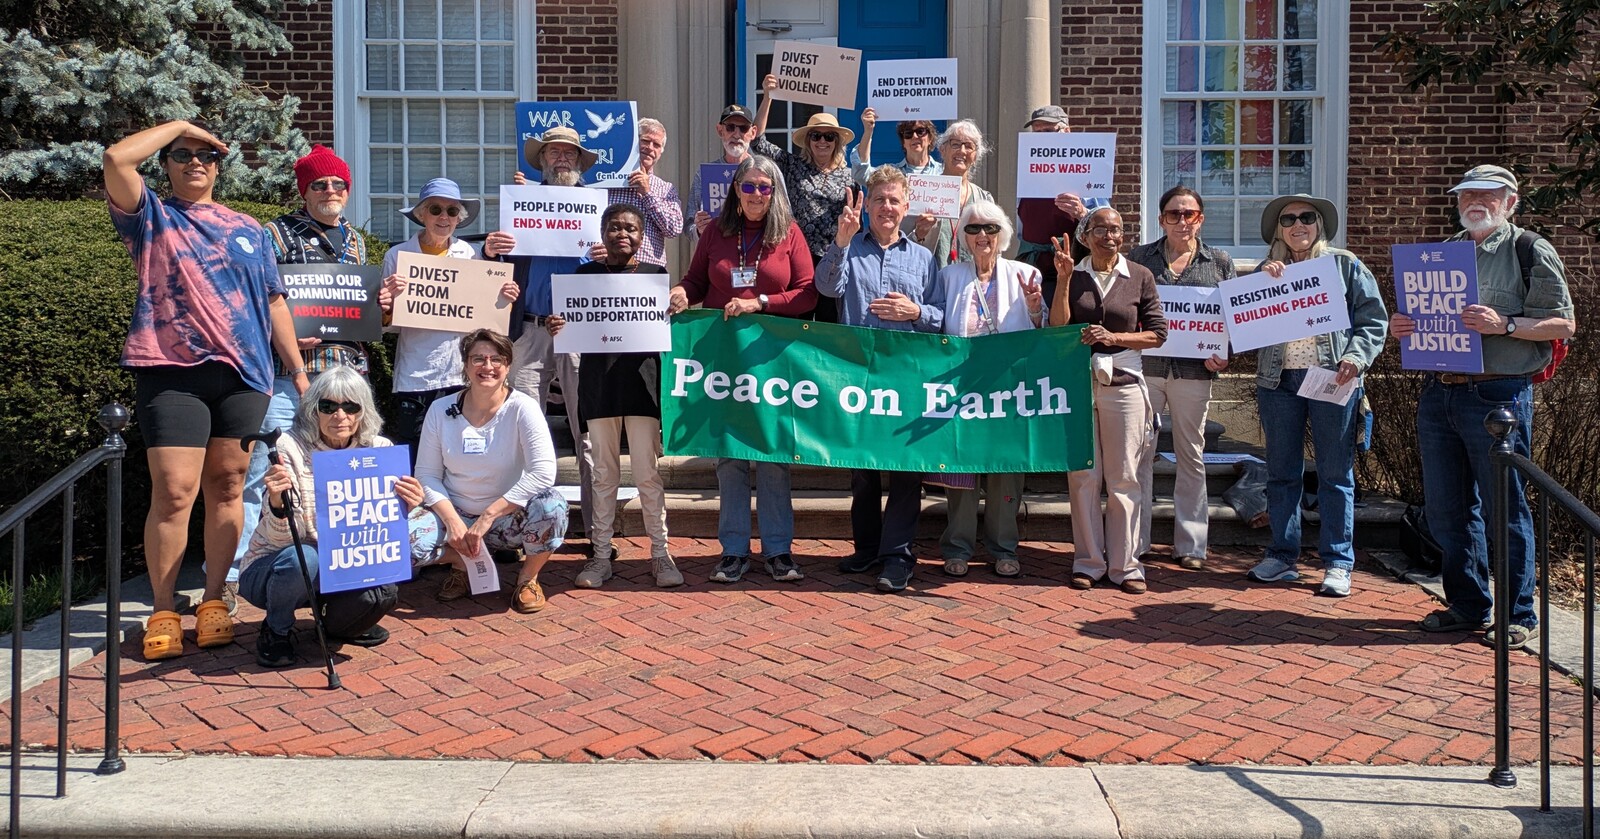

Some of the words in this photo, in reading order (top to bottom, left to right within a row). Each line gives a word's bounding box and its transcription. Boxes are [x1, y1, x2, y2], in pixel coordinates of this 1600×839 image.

[781, 51, 819, 65] DIVEST
[780, 65, 811, 79] FROM
[778, 79, 829, 95] VIOLENCE
[877, 78, 896, 87] END
[897, 76, 947, 86] DETENTION
[872, 88, 891, 98] AND
[893, 87, 953, 97] DEPORTATION
[528, 110, 575, 128] WAR
[1030, 148, 1067, 158] PEOPLE
[1069, 148, 1106, 158] POWER
[1029, 163, 1056, 173] ENDS
[1058, 164, 1091, 174] WARS!
[513, 201, 555, 212] PEOPLE
[557, 203, 598, 215] POWER
[513, 218, 543, 229] ENDS
[545, 219, 582, 230] WARS!
[283, 274, 334, 286] DEFEND
[335, 274, 362, 287] OUR
[409, 265, 459, 283] DIVEST
[1403, 270, 1468, 293] BUILD
[407, 282, 449, 300] FROM
[1229, 283, 1289, 307] RESISTING
[1290, 276, 1321, 292] WAR
[407, 300, 474, 319] VIOLENCE
[566, 297, 589, 308] END
[592, 296, 657, 308] DETENTION
[1194, 302, 1221, 315] WAR
[1233, 302, 1289, 325] BUILDING
[1291, 292, 1329, 311] PEACE
[1405, 293, 1467, 315] PEACE
[293, 305, 342, 318] ABOLISH
[345, 307, 361, 319] ICE
[560, 311, 583, 322] AND
[586, 310, 665, 322] DEPORTATION
[1316, 315, 1332, 324] AFSC
[1189, 320, 1224, 333] PEACE
[1416, 315, 1458, 332] with
[1408, 333, 1471, 352] JUSTICE
[671, 358, 820, 409] Peace
[839, 384, 903, 417] on
[922, 376, 1072, 419] Earth
[326, 475, 399, 505] BUILD
[328, 498, 400, 529] PEACE
[340, 523, 389, 547] with
[329, 541, 401, 571] JUSTICE
